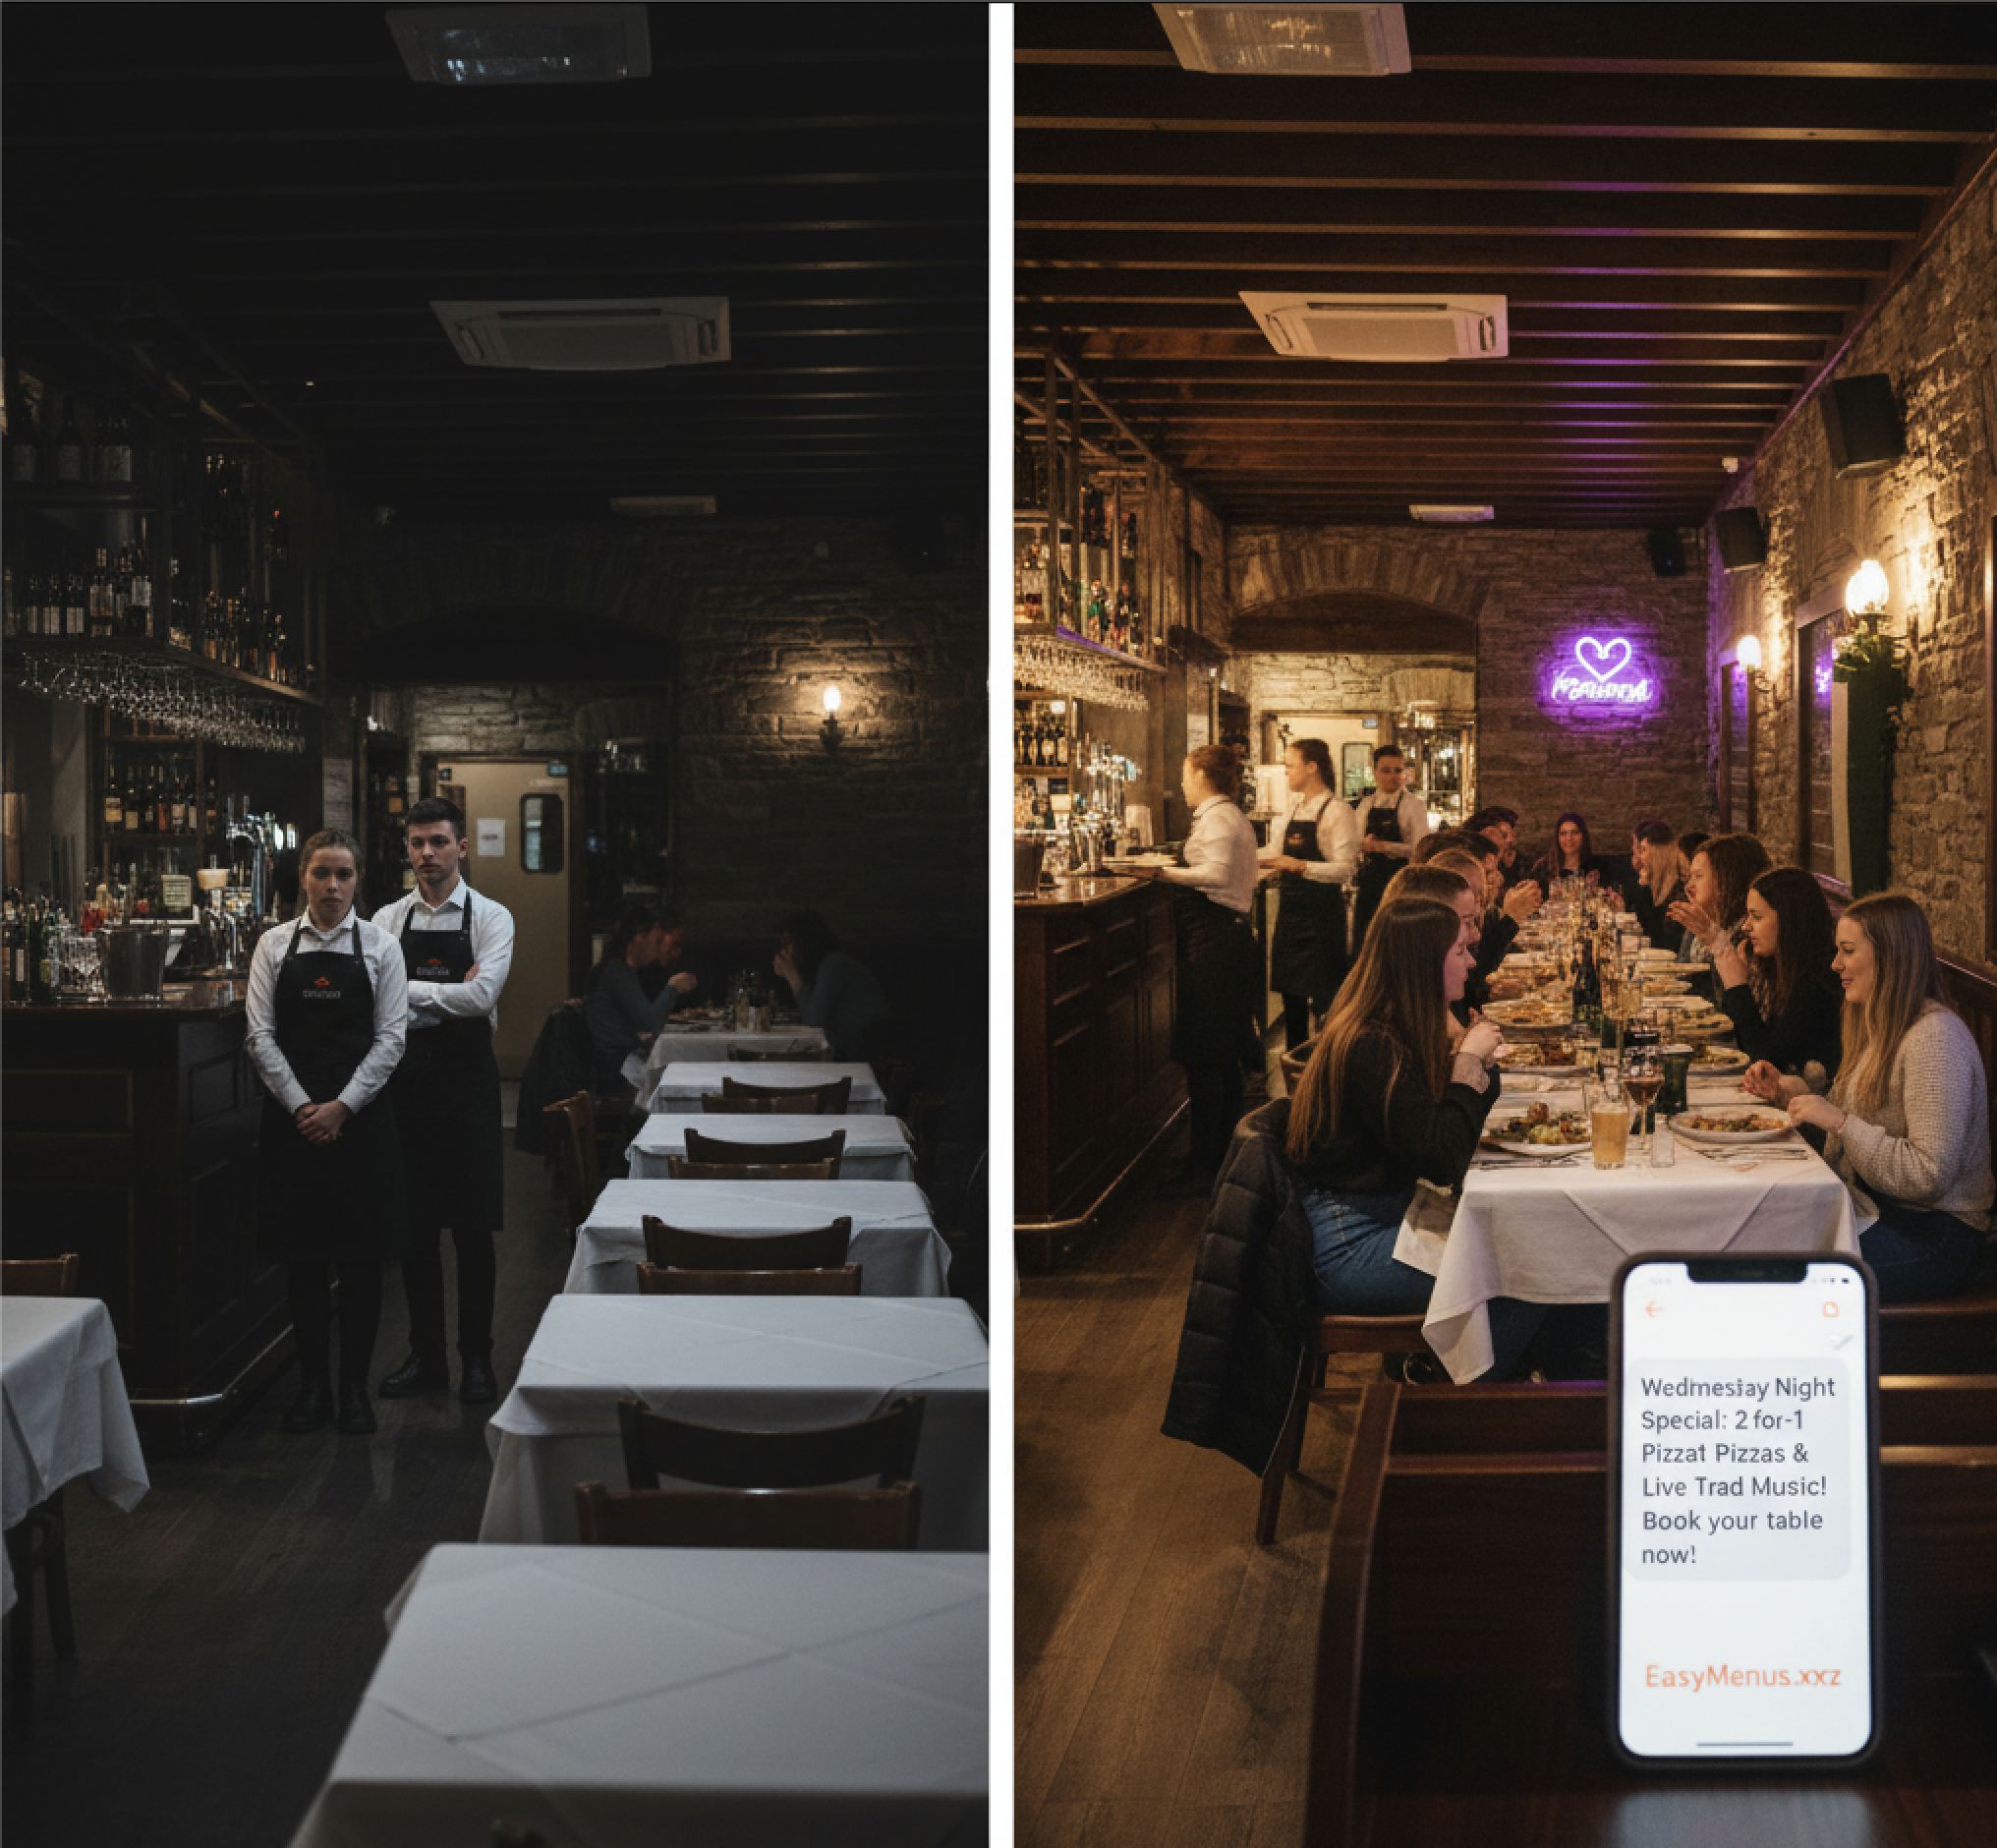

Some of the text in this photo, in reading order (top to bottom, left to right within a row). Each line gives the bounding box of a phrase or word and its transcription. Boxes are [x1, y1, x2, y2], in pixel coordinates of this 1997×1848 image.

[1775, 1376, 1836, 1402] Night
[1640, 1410, 1802, 1435] Special: 2 for-1
[1715, 1442, 1786, 1464] Pizzas
[1792, 1442, 1809, 1464] &
[1642, 1475, 1827, 1497] Live Trad Music!
[1642, 1509, 1824, 1536] Book your table
[1641, 1544, 1697, 1565] now!
[1645, 1664, 1842, 1693] EasyMenus.xxz
